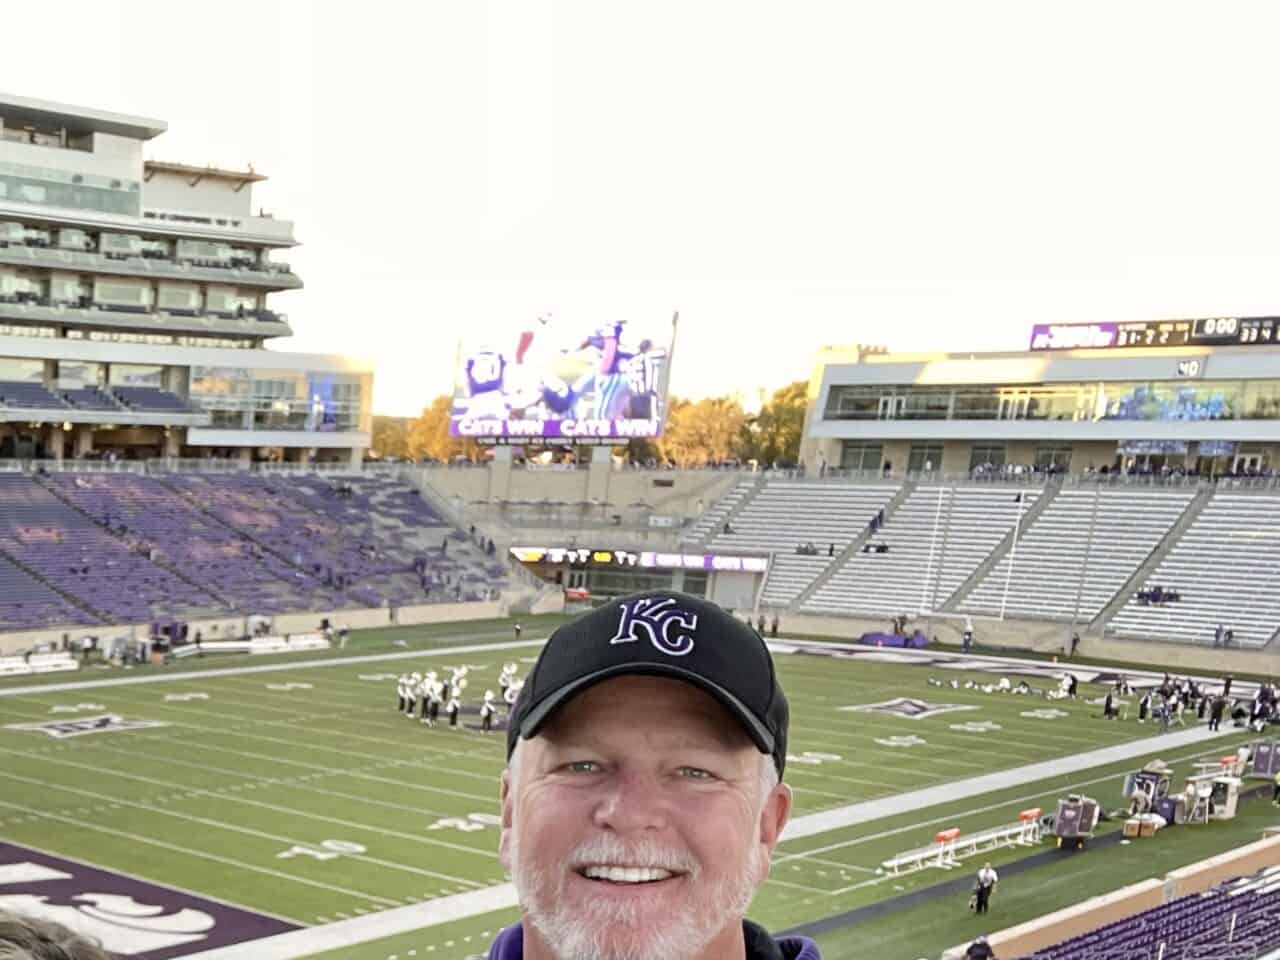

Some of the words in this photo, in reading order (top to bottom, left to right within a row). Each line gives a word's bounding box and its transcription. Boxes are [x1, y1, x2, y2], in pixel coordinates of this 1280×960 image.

[507, 418, 545, 435] WIN
[560, 418, 611, 435] CATS
[614, 418, 658, 436] WIN
[610, 597, 698, 656] KC
